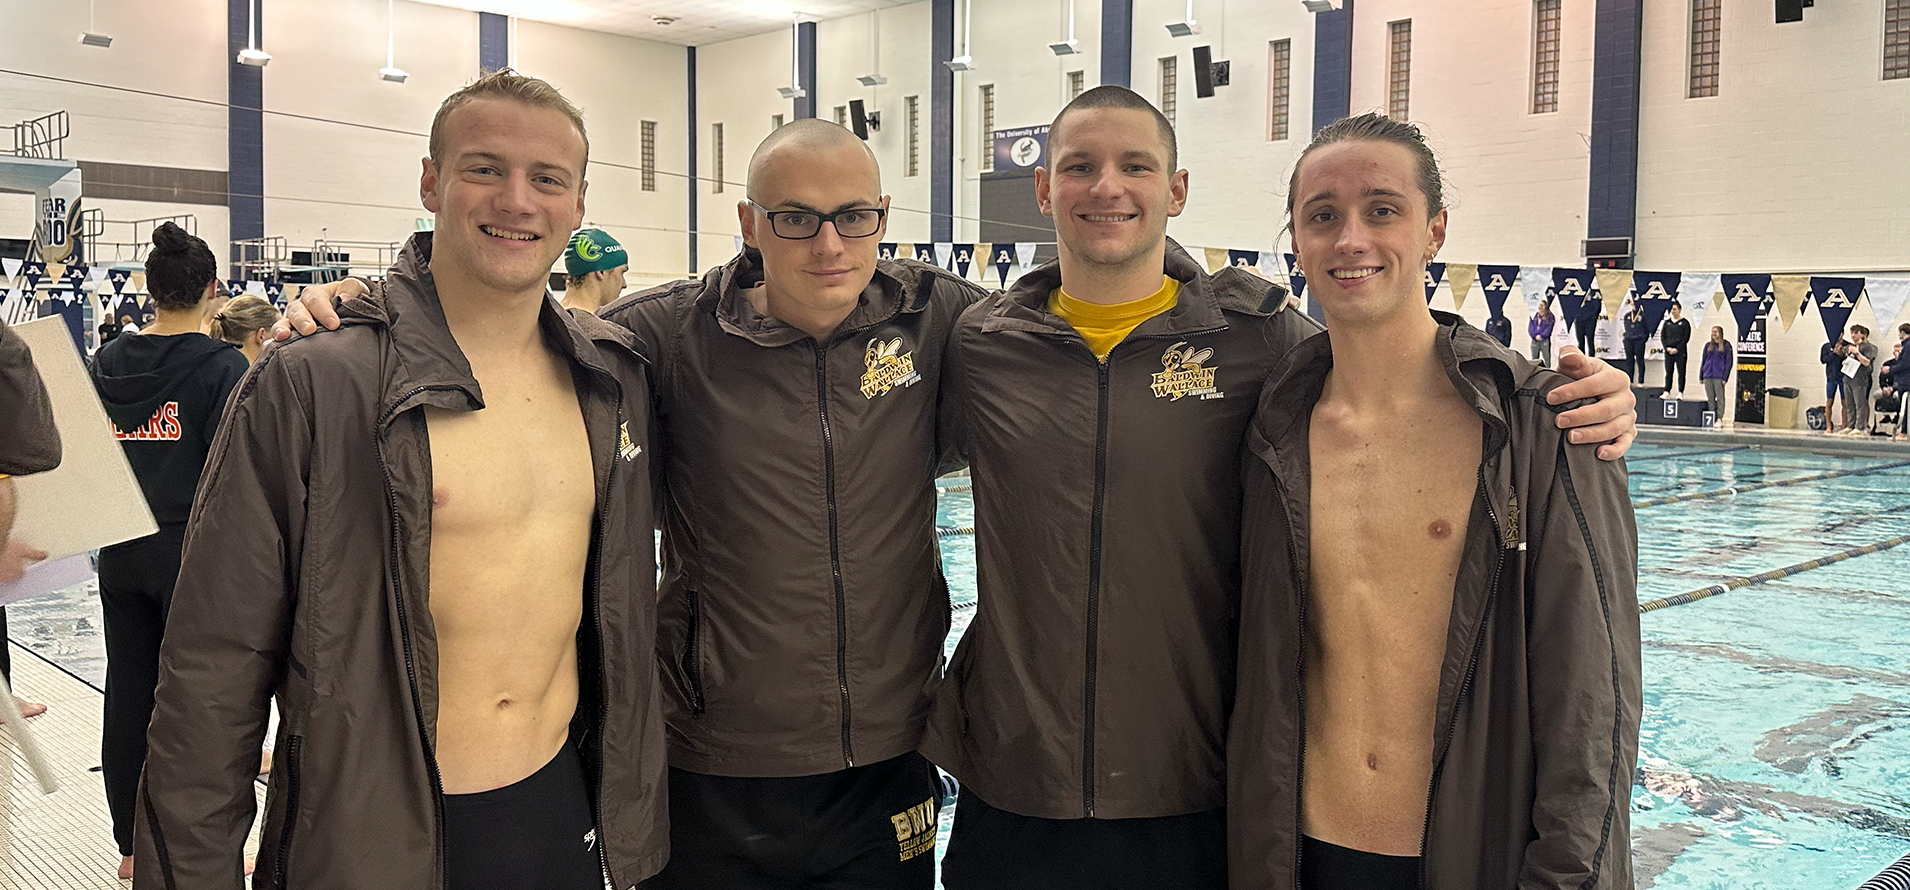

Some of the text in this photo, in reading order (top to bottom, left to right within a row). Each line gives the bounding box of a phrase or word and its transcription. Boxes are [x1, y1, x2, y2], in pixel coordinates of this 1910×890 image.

[1007, 129, 1032, 137] University
[920, 250, 932, 262] A
[957, 250, 970, 262] A
[996, 250, 1011, 263] A
[26, 265, 42, 275] A
[70, 269, 85, 279] A
[112, 273, 126, 283] A
[1485, 274, 1510, 291] A
[1558, 278, 1587, 295] A
[1641, 281, 1671, 299] A
[1730, 283, 1761, 302] A
[1820, 288, 1854, 308] A
[862, 354, 911, 387] BALDWIN
[1155, 368, 1214, 385] BALDWIN
[863, 364, 913, 398] WALLACE
[1153, 379, 1213, 397] WALLACE
[1667, 405, 1674, 414] 5
[1706, 416, 1712, 425] 7
[891, 796, 934, 841] BWU
